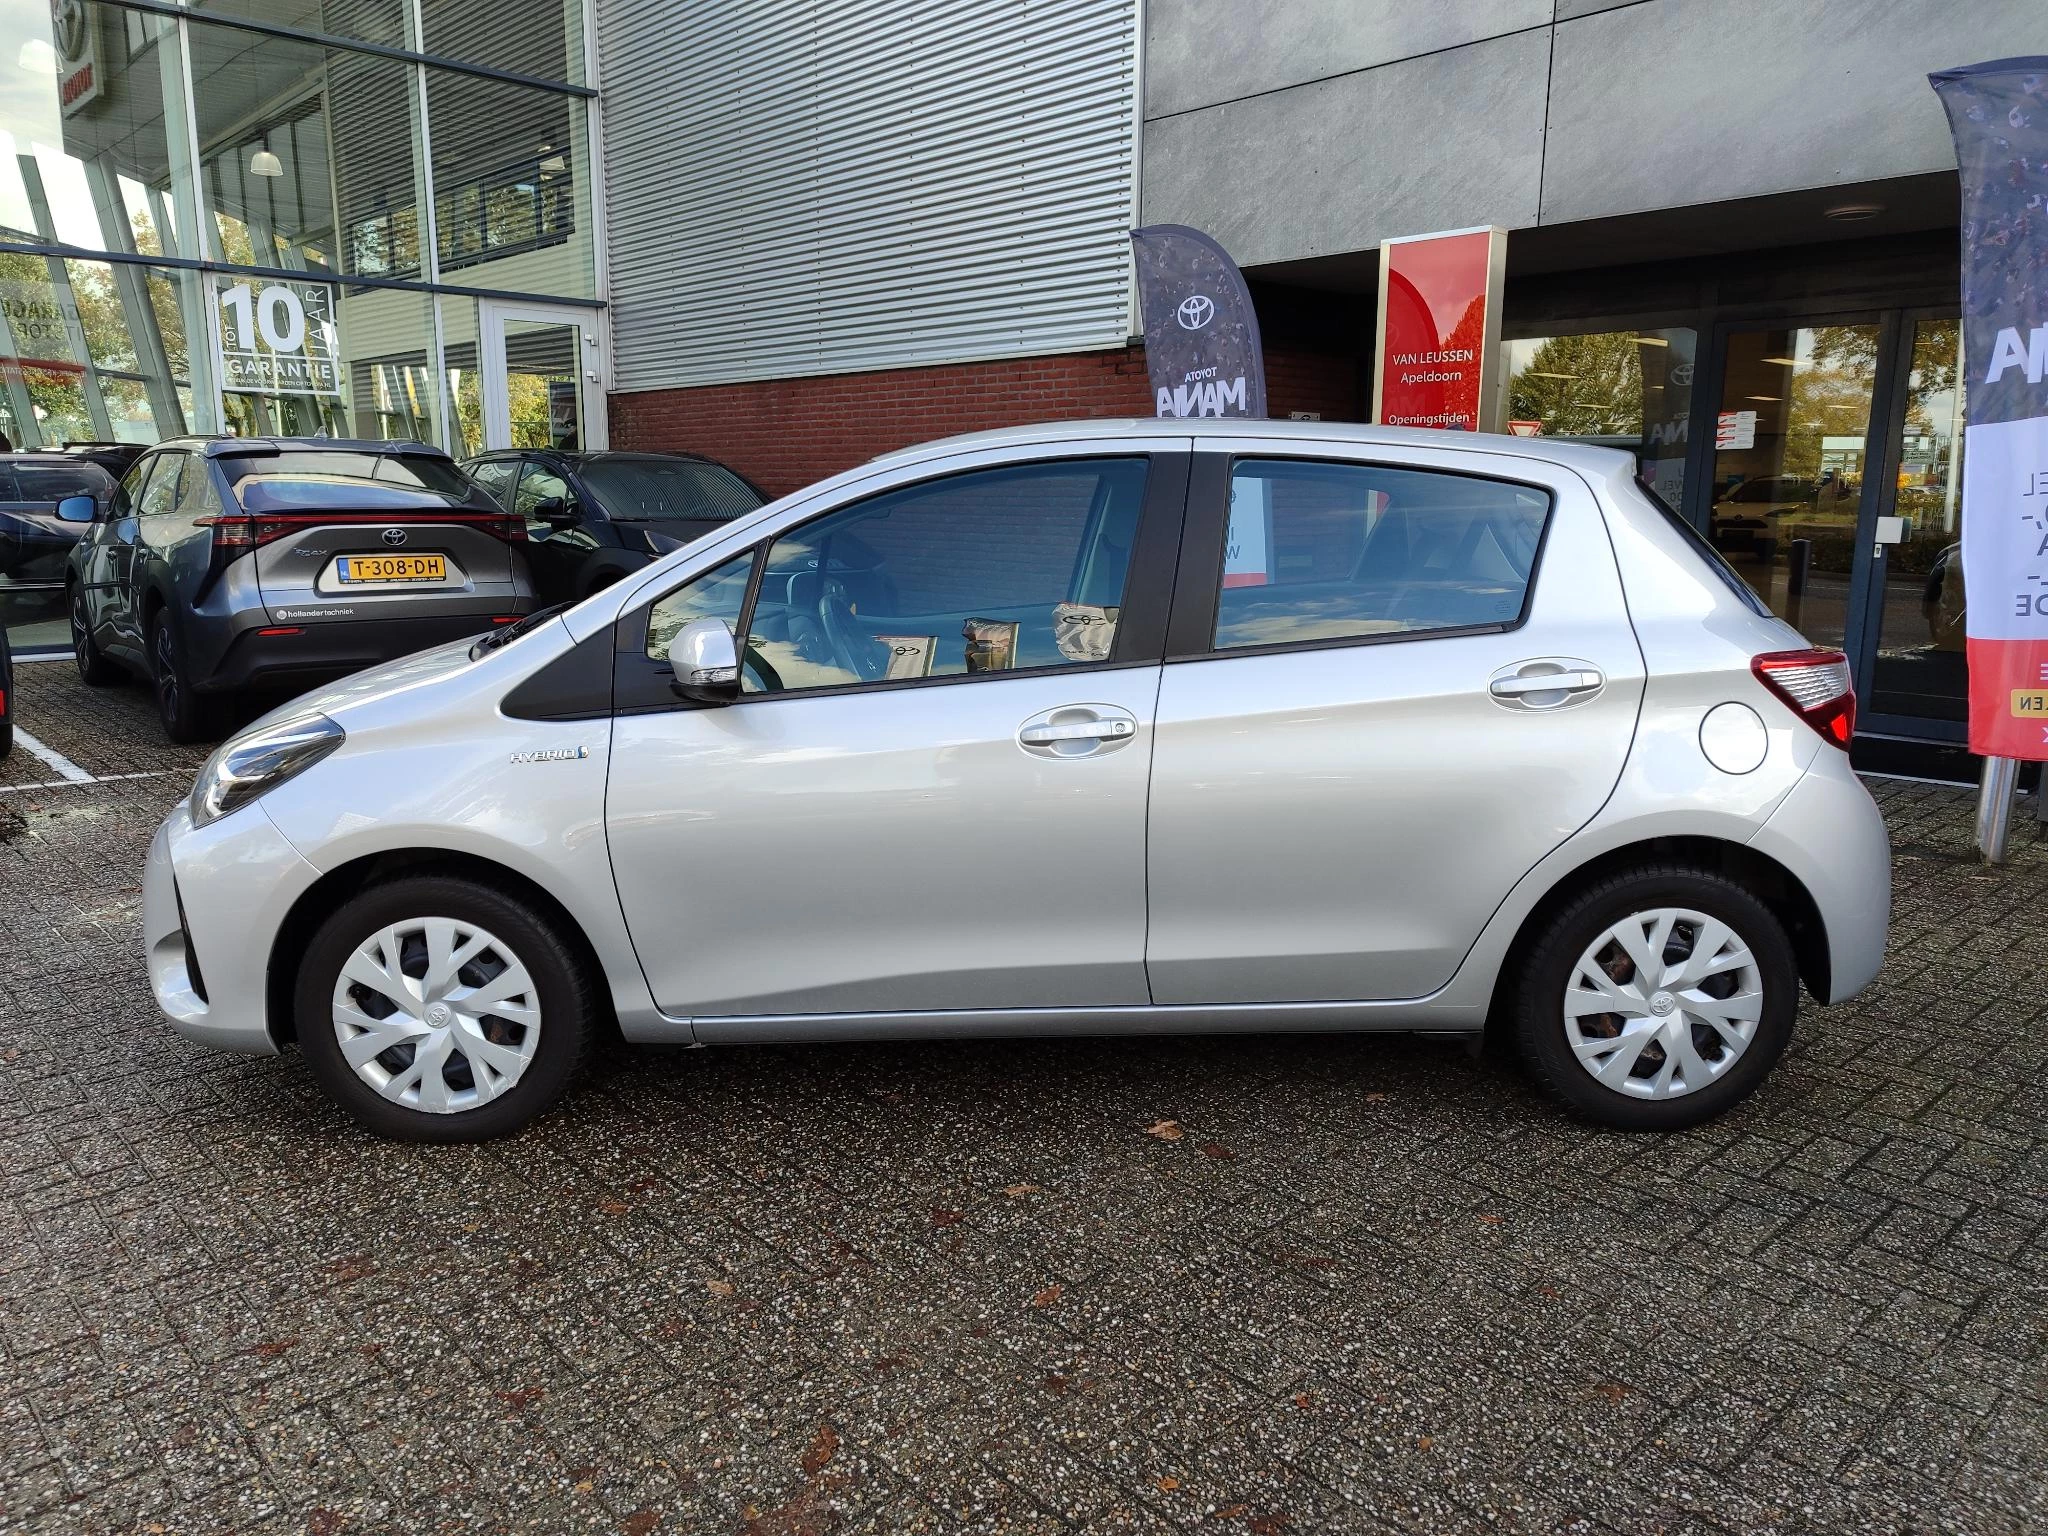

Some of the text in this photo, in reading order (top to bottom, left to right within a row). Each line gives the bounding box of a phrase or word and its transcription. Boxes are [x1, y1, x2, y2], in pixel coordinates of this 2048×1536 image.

[221, 283, 305, 352] 10
[306, 289, 329, 350] JAAR
[225, 326, 237, 348] TOT
[1392, 349, 1473, 365] VAN LEUSSEN
[228, 360, 331, 379] GARANTIE
[1400, 370, 1462, 385] Apeldoorn
[1388, 412, 1470, 426] Openingstijden
[353, 559, 439, 576] T-308-DH
[510, 749, 575, 763] HYBRID
